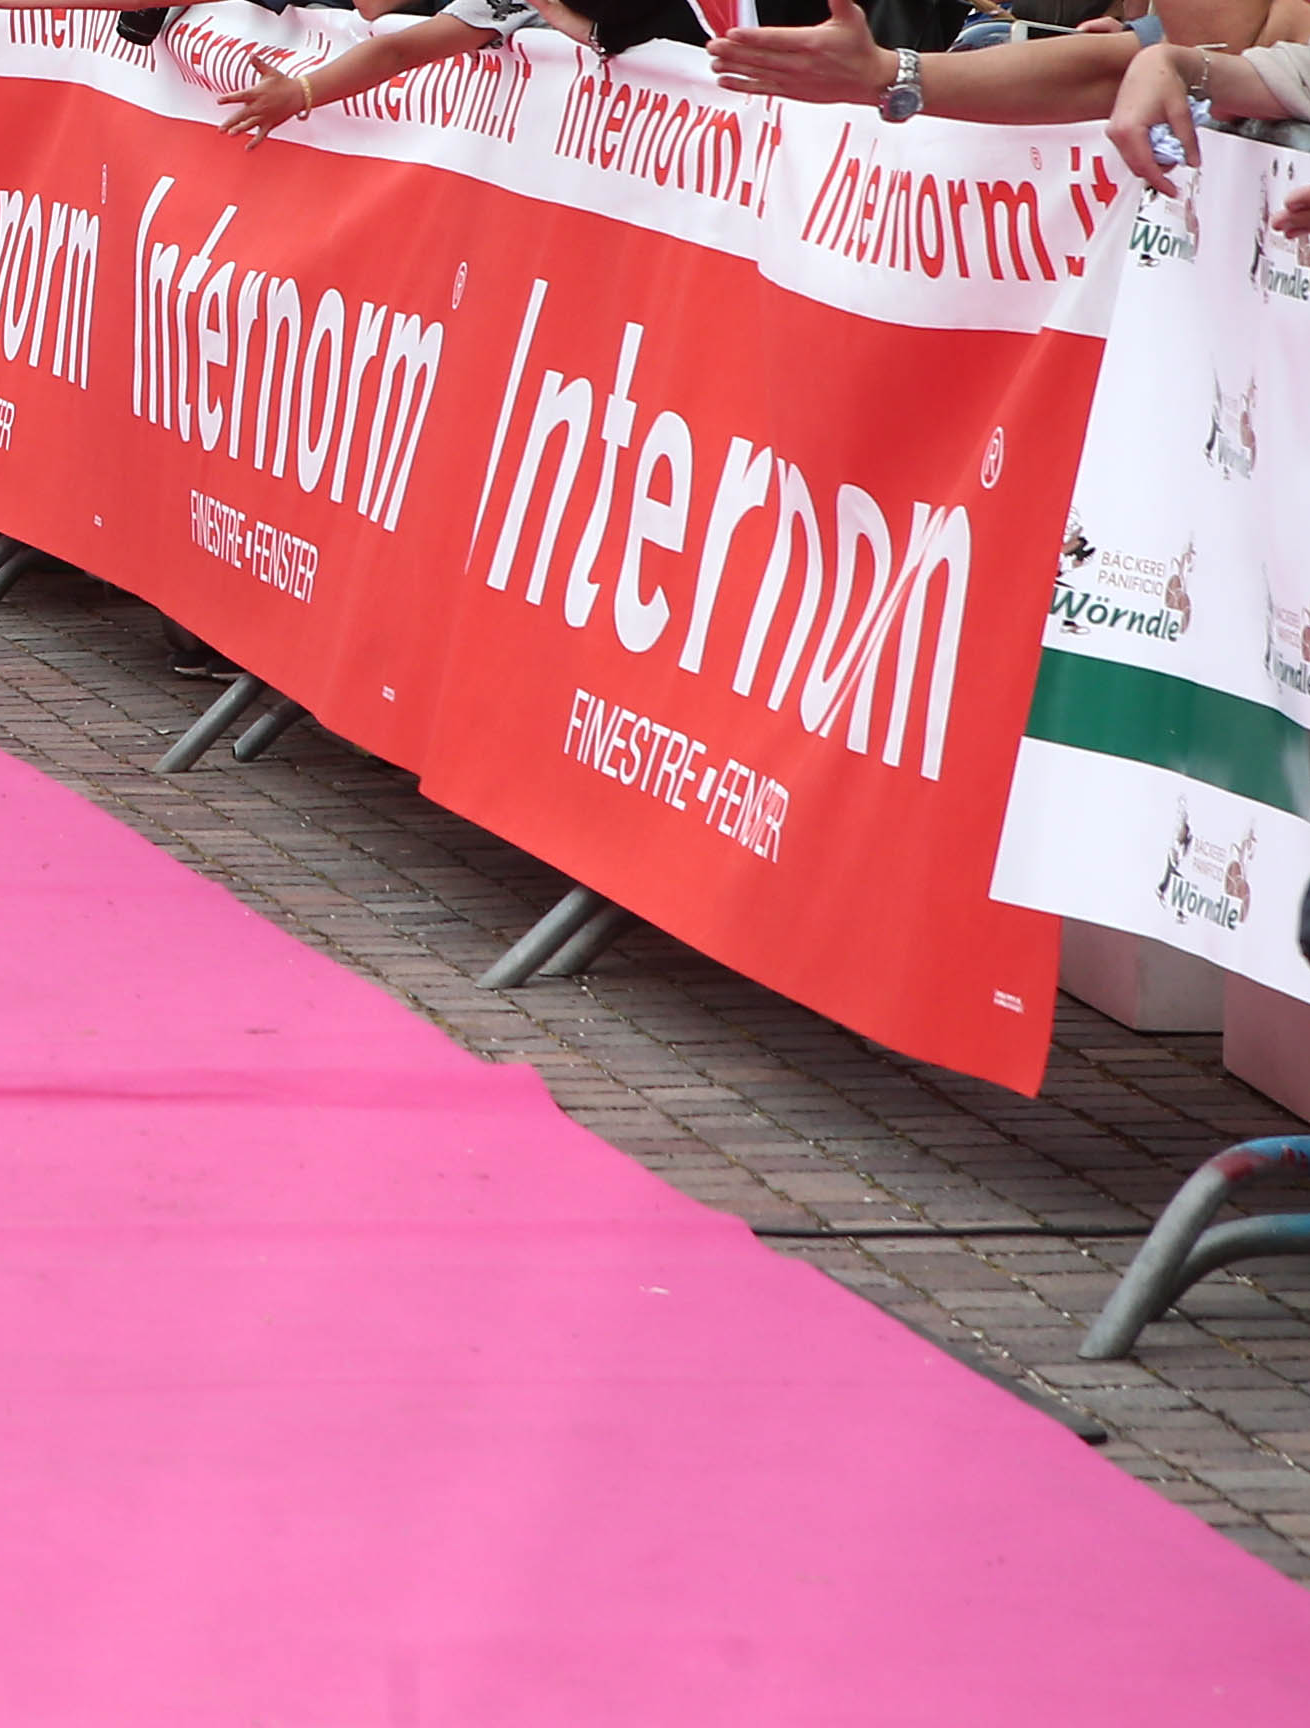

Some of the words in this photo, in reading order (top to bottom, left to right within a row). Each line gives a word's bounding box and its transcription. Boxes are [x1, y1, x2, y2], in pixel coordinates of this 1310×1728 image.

[132, 176, 444, 533] Internorm
[1097, 570, 1164, 598] PANIFICIO
[1101, 550, 1166, 578] BÄCKEREI
[1051, 585, 1181, 643] Wörndle
[563, 688, 707, 812] FINESTRE
